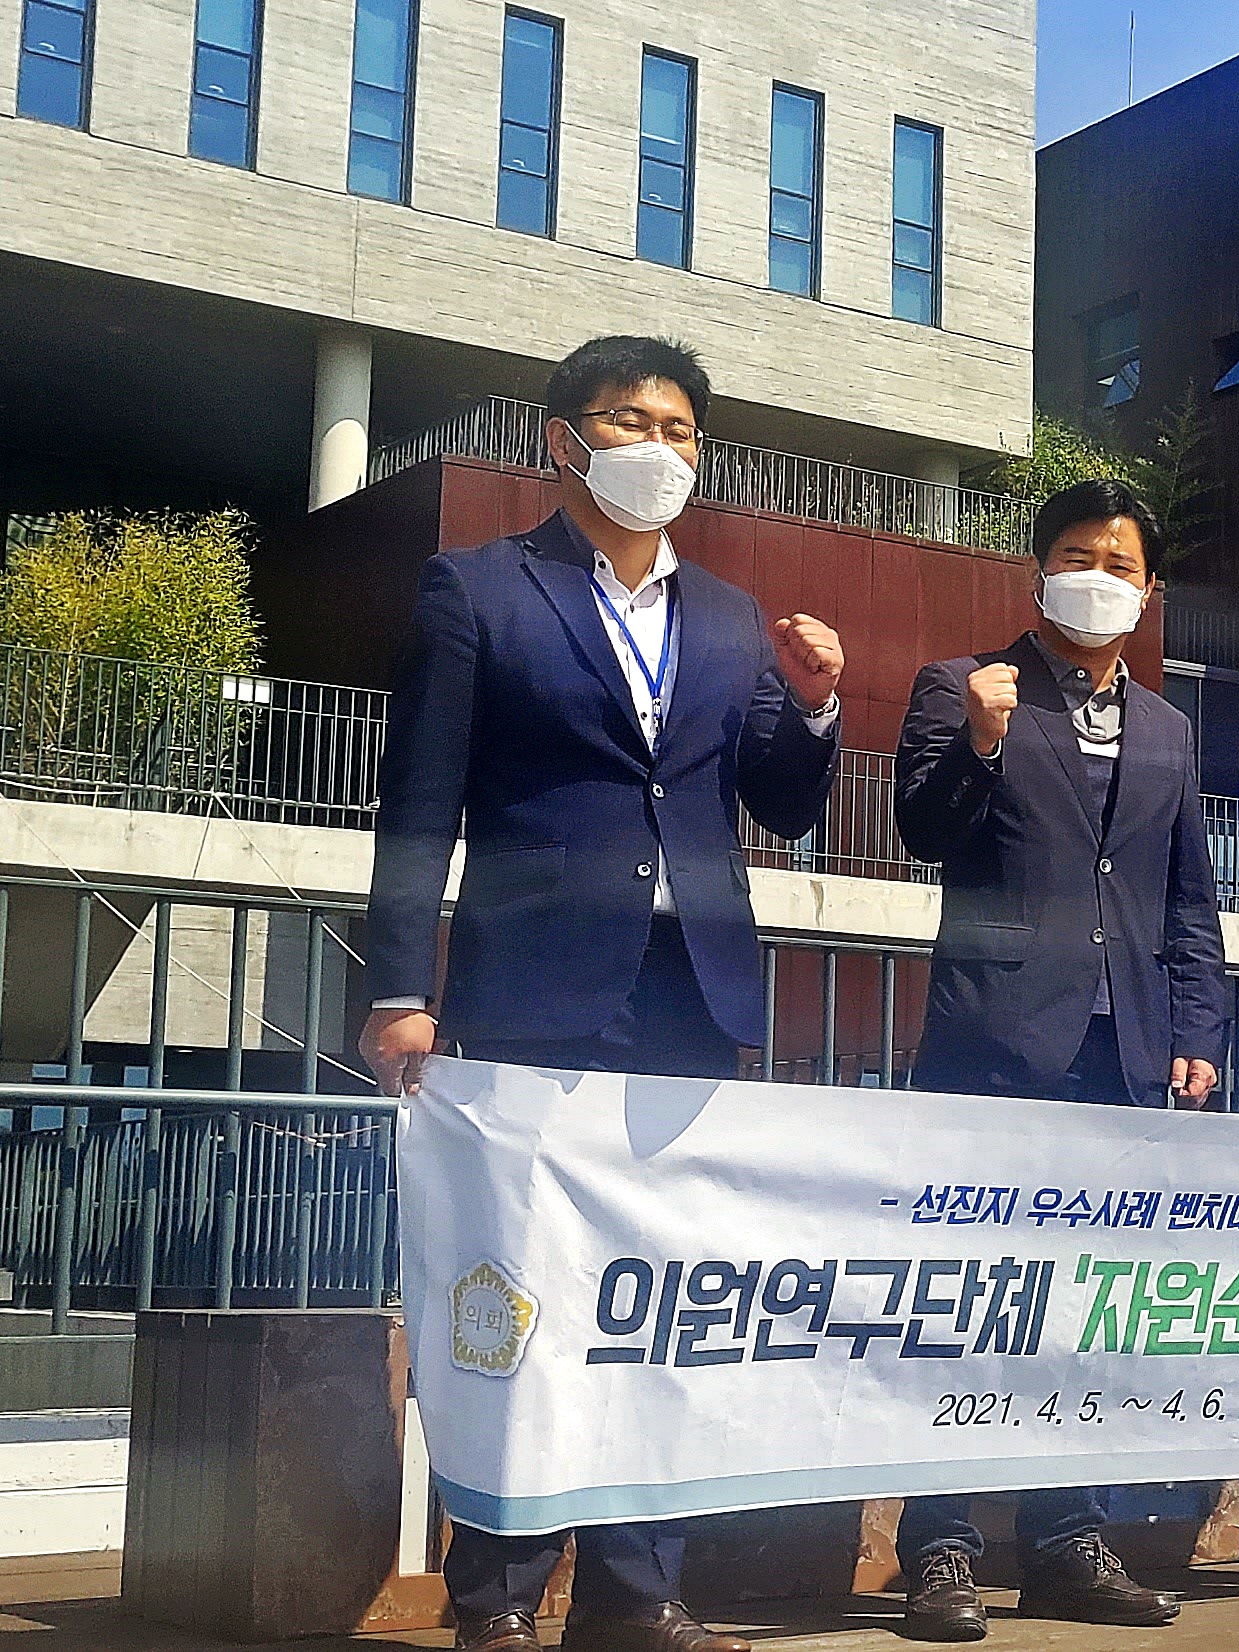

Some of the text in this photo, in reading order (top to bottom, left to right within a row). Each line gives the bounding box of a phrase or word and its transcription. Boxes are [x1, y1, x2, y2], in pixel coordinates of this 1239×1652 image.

[911, 1184, 1020, 1226] 선진지
[1026, 1187, 1162, 1229] 우수사례
[464, 1305, 503, 1335] 의회
[586, 1256, 1056, 1368] 의원연구단체
[932, 1392, 1020, 1427] 2021.
[1036, 1391, 1063, 1425] 4.
[1078, 1391, 1104, 1424] 5.
[1161, 1389, 1186, 1422] 4.
[1202, 1388, 1225, 1421] 6.
